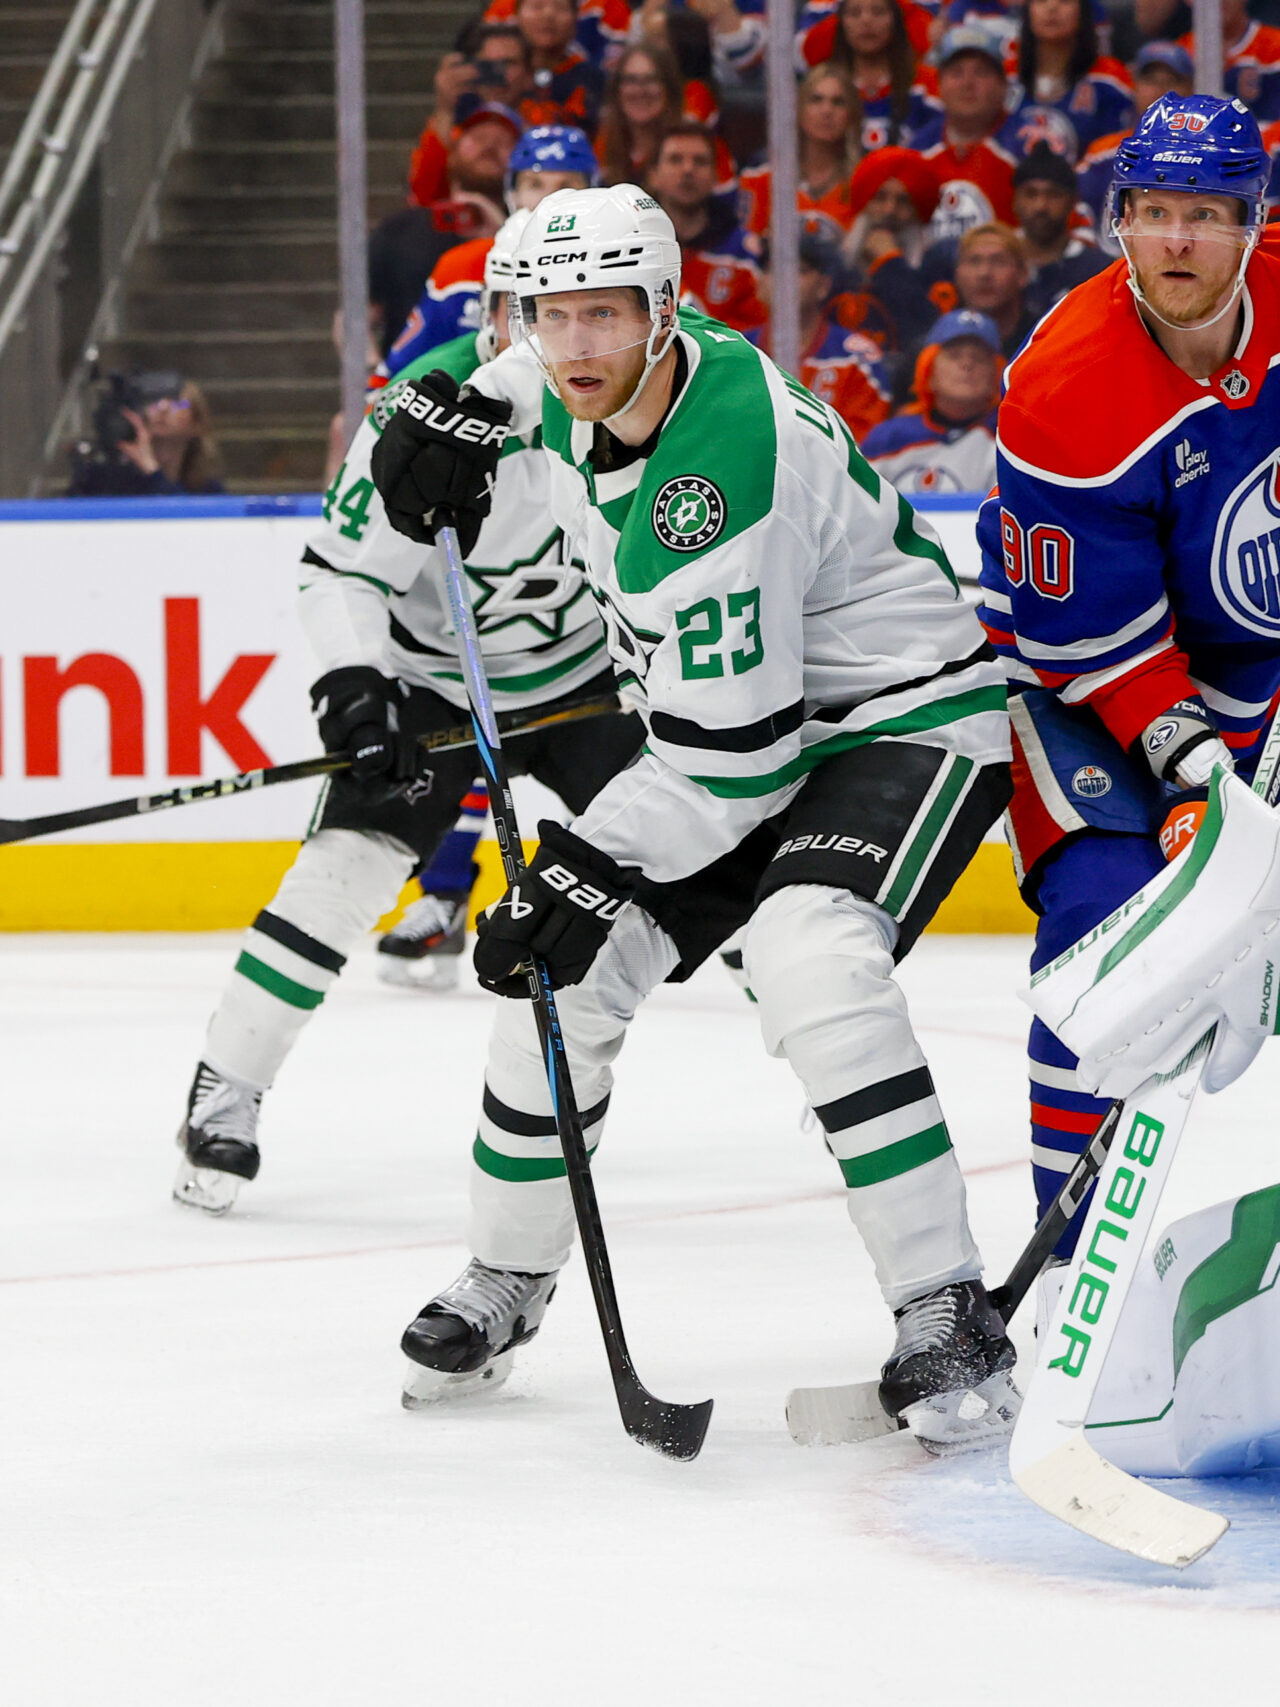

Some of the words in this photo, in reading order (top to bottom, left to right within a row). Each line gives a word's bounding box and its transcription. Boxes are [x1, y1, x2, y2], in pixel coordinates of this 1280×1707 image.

[547, 215, 577, 233] 23
[537, 251, 589, 266] CCM
[1174, 462, 1210, 489] alberta
[1185, 449, 1208, 472] play
[657, 481, 711, 524] DALLAS
[669, 510, 720, 546] STARS
[1000, 505, 1075, 602] 90
[674, 585, 765, 681] 23
[0, 597, 279, 777] nk
[1159, 811, 1197, 863] ER
[1260, 959, 1275, 1027] SHADOW
